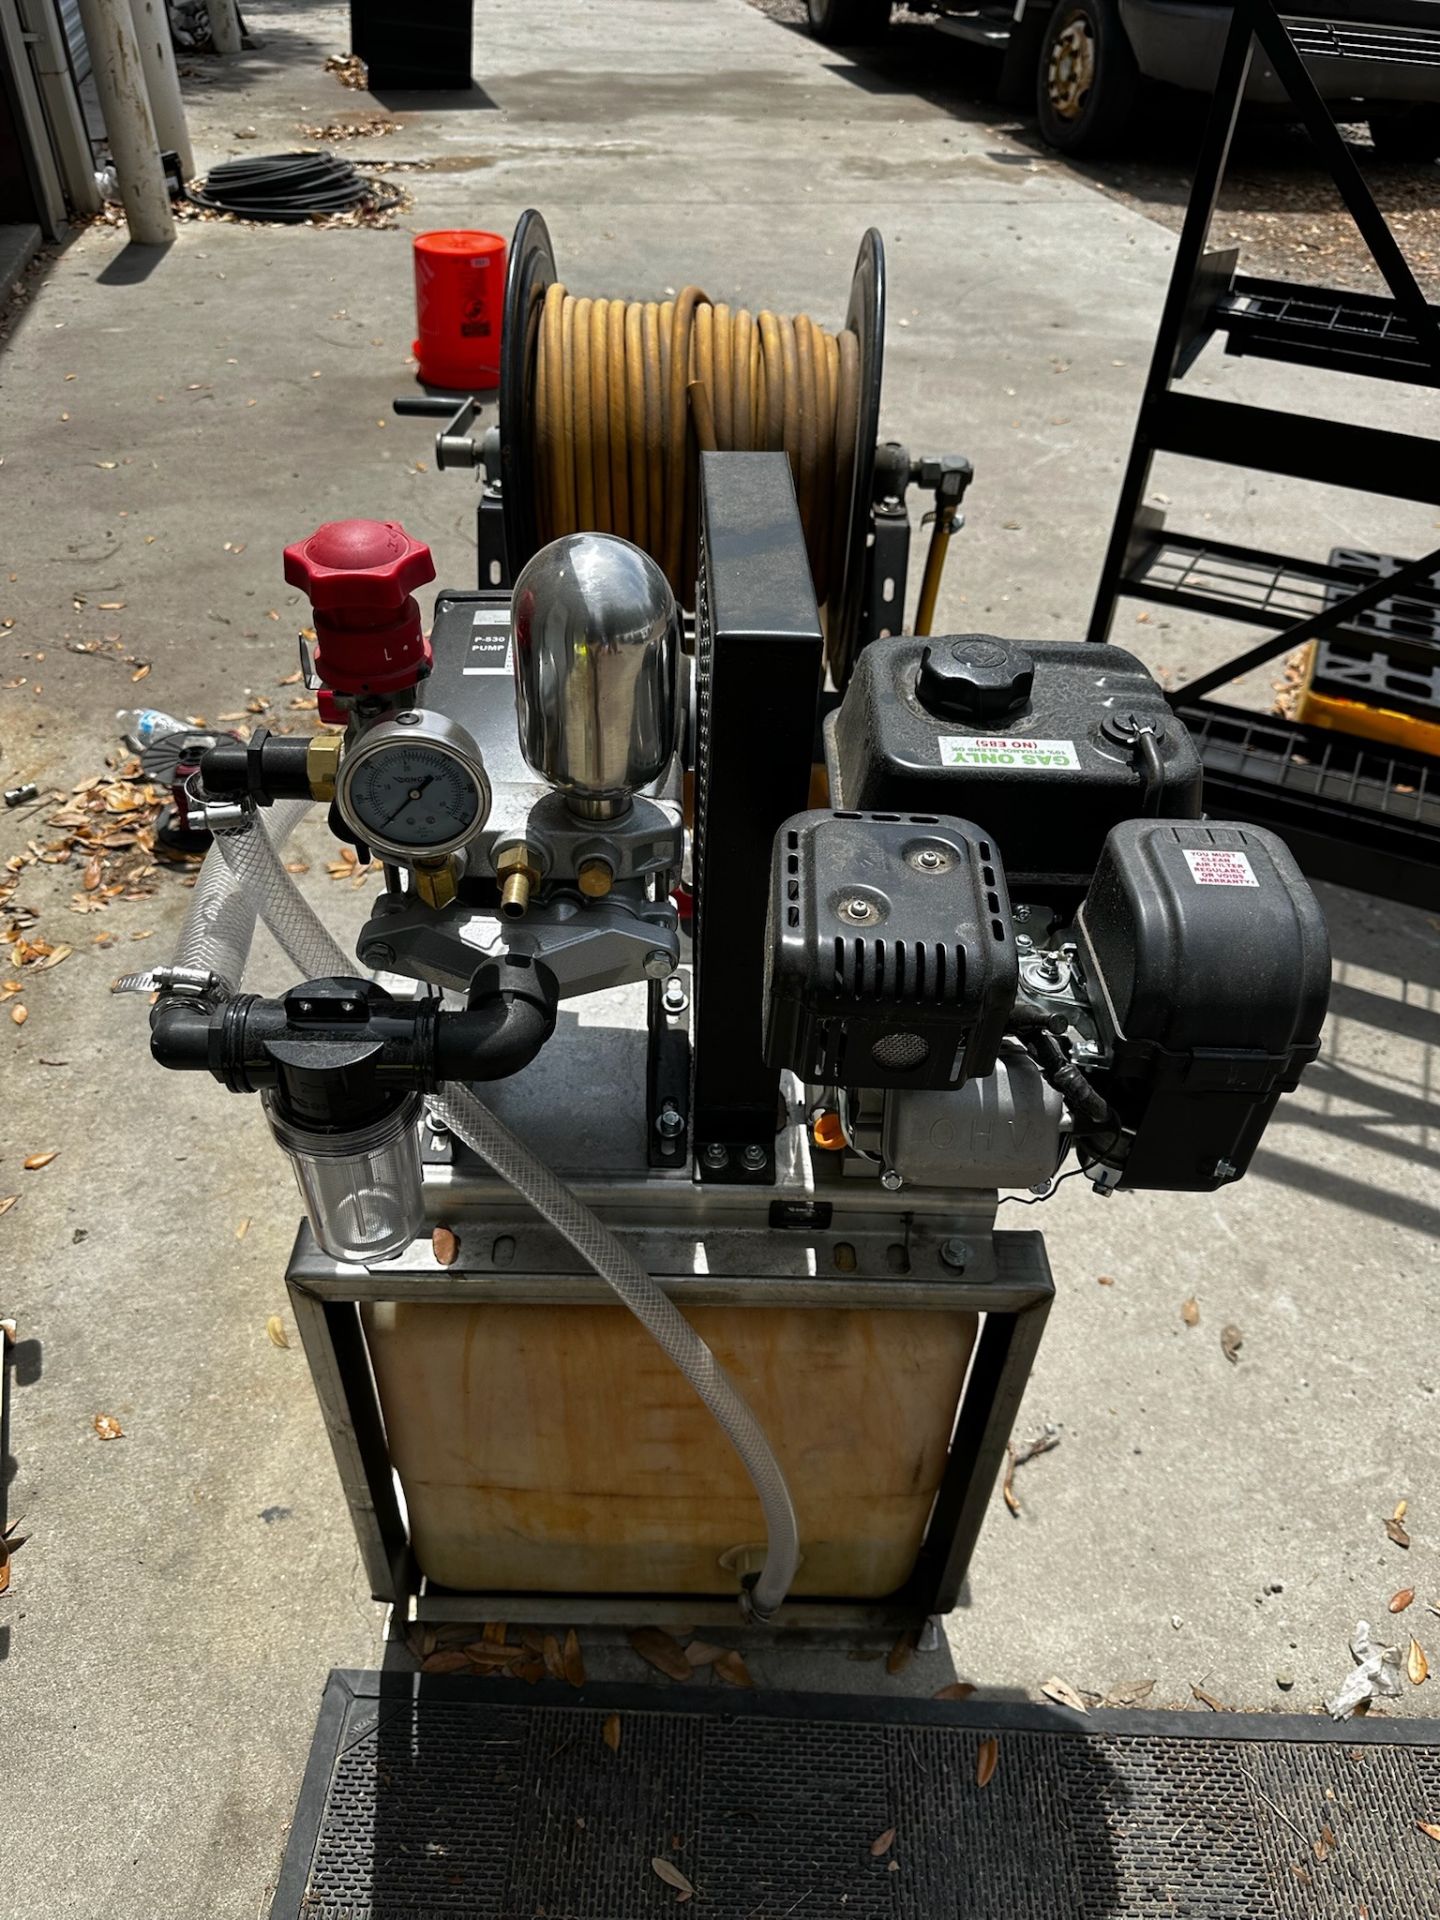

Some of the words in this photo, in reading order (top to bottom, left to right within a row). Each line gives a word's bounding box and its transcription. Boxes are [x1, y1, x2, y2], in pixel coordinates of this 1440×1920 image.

[384, 648, 392, 661] L
[975, 739, 1007, 748] E85)
[1011, 741, 1038, 749] (NO
[953, 752, 1015, 765] ONLY
[1021, 755, 1071, 767] GAS
